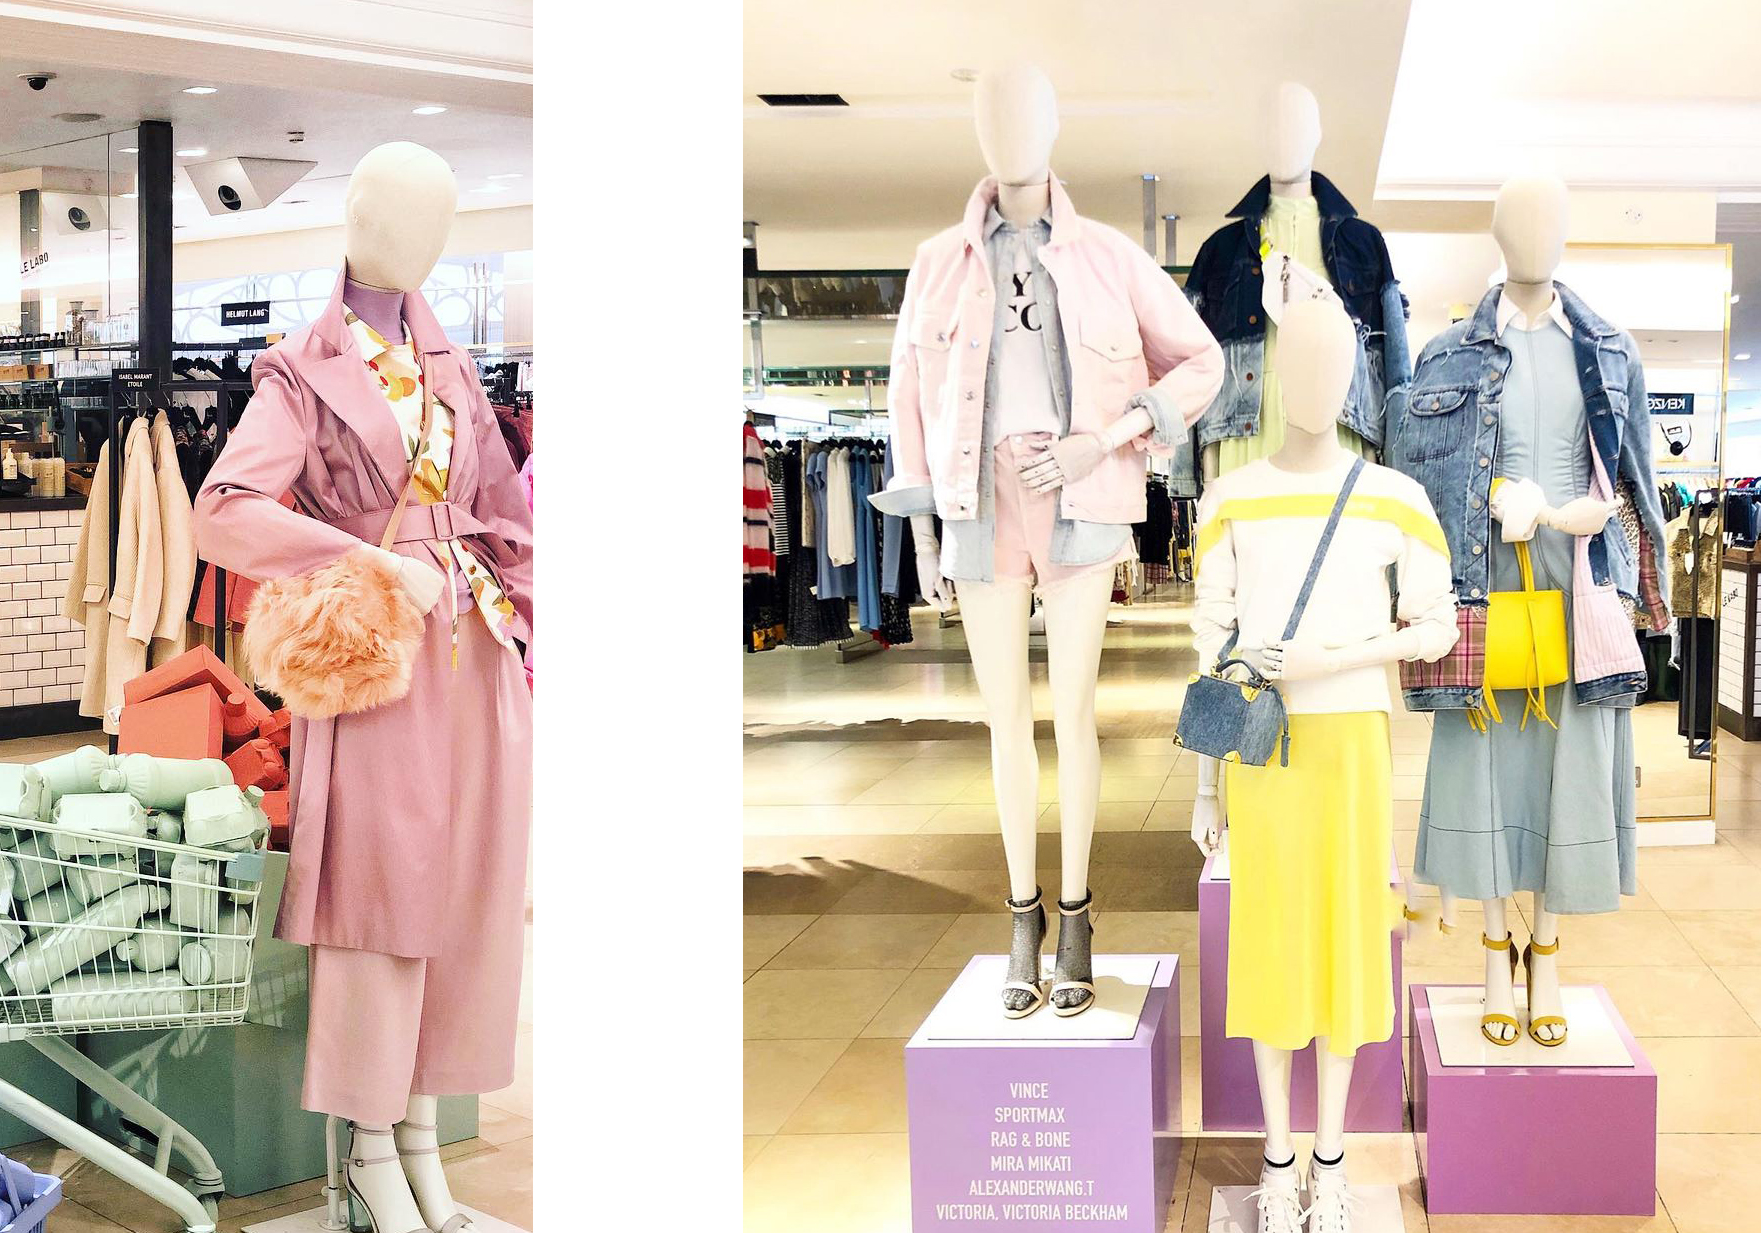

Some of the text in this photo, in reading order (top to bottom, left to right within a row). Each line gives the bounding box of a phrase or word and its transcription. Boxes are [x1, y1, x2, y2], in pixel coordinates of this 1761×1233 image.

[29, 252, 49, 269] LABO
[225, 309, 248, 319] HELMUT
[1009, 1083, 1049, 1099] VINCE
[994, 1107, 1066, 1123] SPORTMAX
[990, 1131, 1072, 1148] RAG & BONE
[990, 1156, 1072, 1172] MIRA MIKATI
[969, 1180, 1095, 1196] ALEXANDERWANG.T
[936, 1204, 1129, 1221] VICTORIA, VICTORIA BECKHAM
